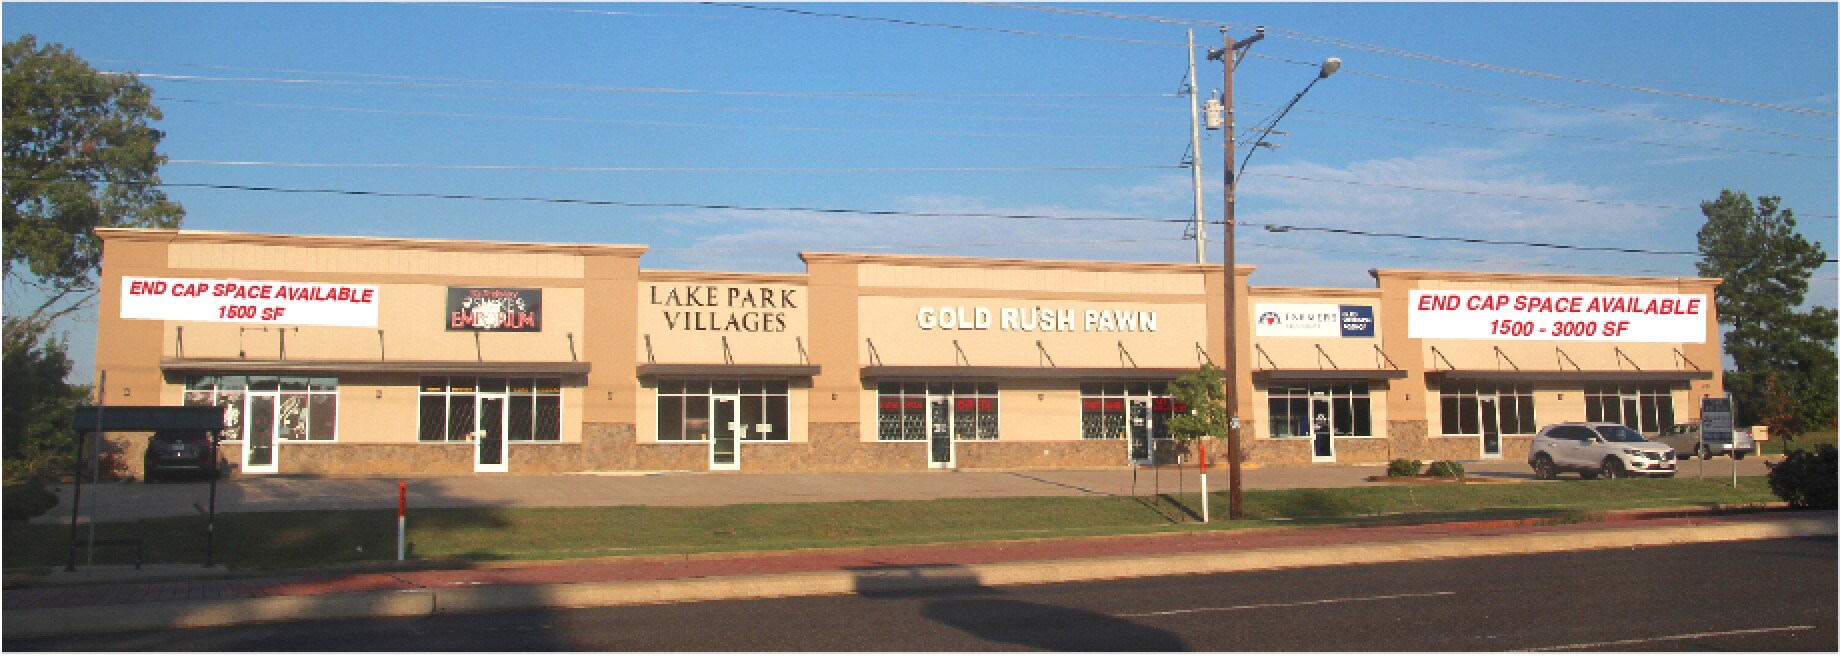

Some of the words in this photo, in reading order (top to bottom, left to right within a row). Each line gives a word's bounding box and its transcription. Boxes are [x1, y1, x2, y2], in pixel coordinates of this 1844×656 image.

[130, 281, 168, 295] END
[171, 283, 210, 297] CAP
[212, 284, 273, 299] SPACE
[274, 285, 374, 303] AVAILABLE
[650, 285, 719, 307] LAKE
[727, 287, 798, 308] PARK
[218, 305, 257, 319] 1500
[261, 307, 286, 321] SF
[1417, 295, 1461, 311] END
[1466, 295, 1510, 312] CAP
[1514, 295, 1584, 313] SPACE
[1585, 296, 1701, 315] AVAILABLE
[662, 310, 787, 332] VILLAGES
[916, 305, 991, 330] GOLD
[1000, 306, 1075, 332] RUSH
[1084, 309, 1157, 332] PAWN
[1490, 319, 1535, 337] 1500
[1551, 320, 1598, 337] 3000
[1601, 320, 1630, 337] SF
